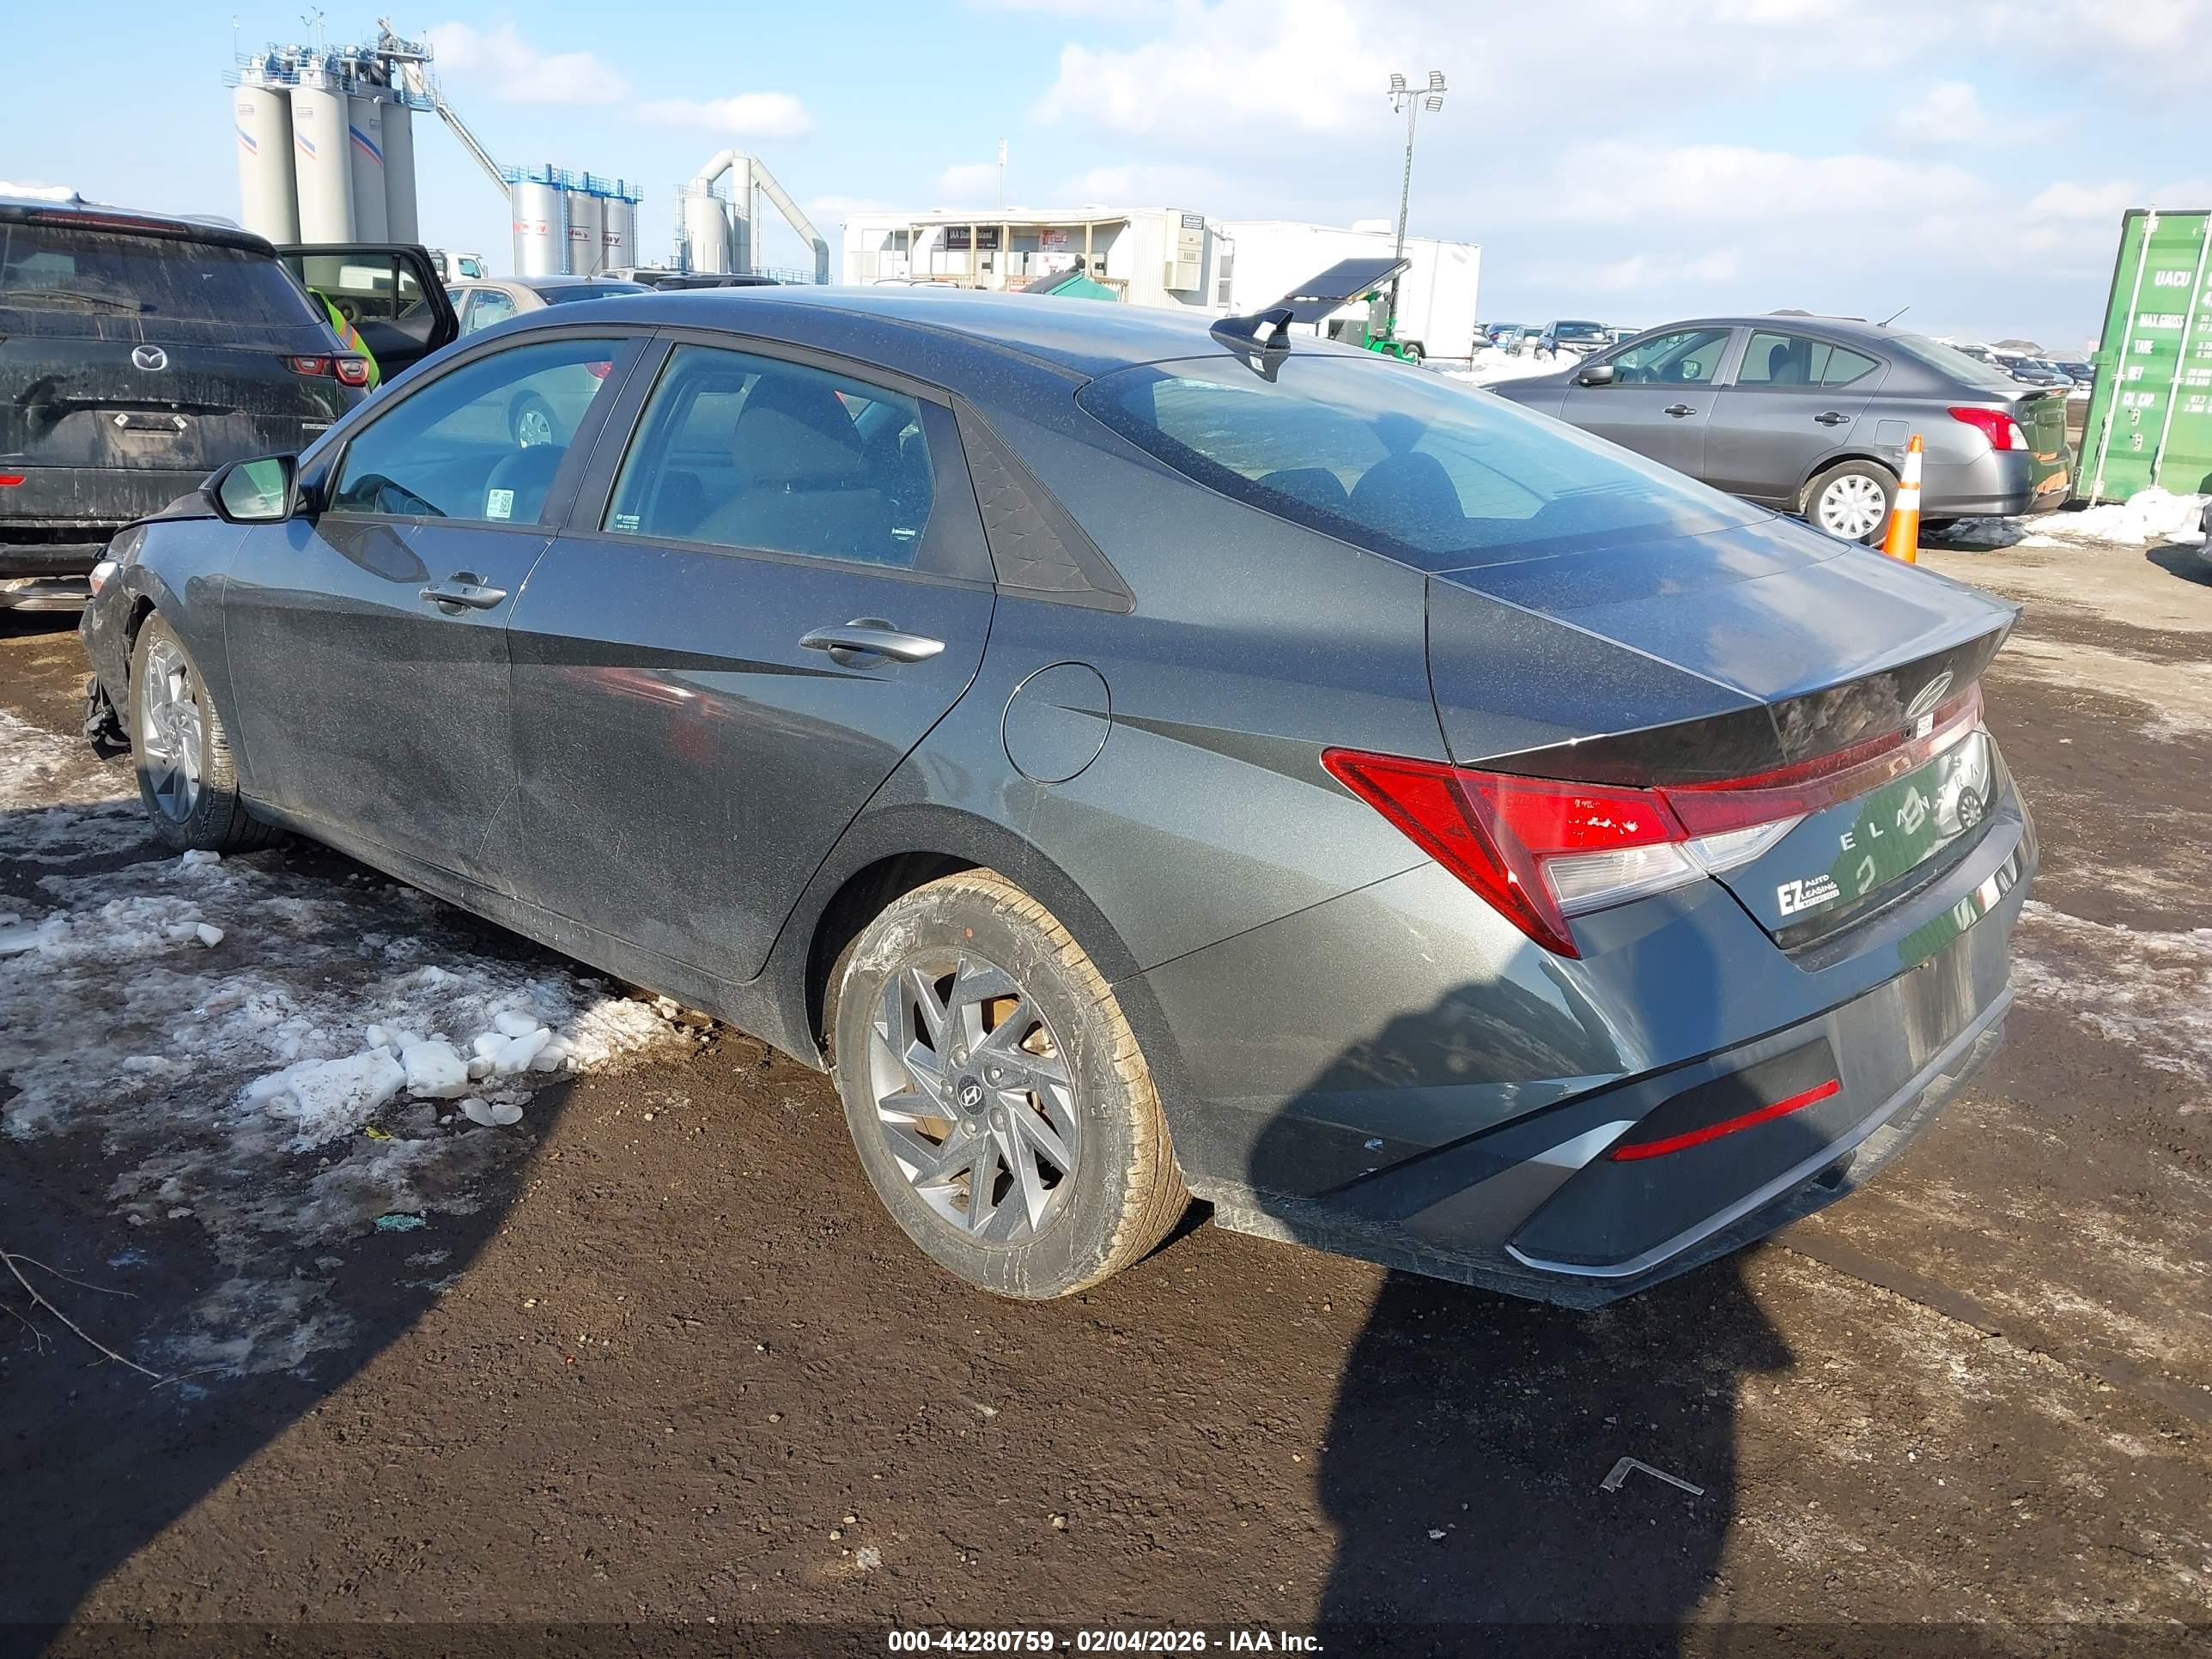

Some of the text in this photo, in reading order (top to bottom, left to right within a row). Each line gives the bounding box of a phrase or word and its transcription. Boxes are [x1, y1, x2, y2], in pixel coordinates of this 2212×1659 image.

[2154, 270, 2191, 287] UACU
[2134, 339, 2154, 354] TARE
[1805, 874, 1830, 888] AUTO
[1778, 878, 1802, 916] EZ
[1801, 882, 1838, 900] LEASING
